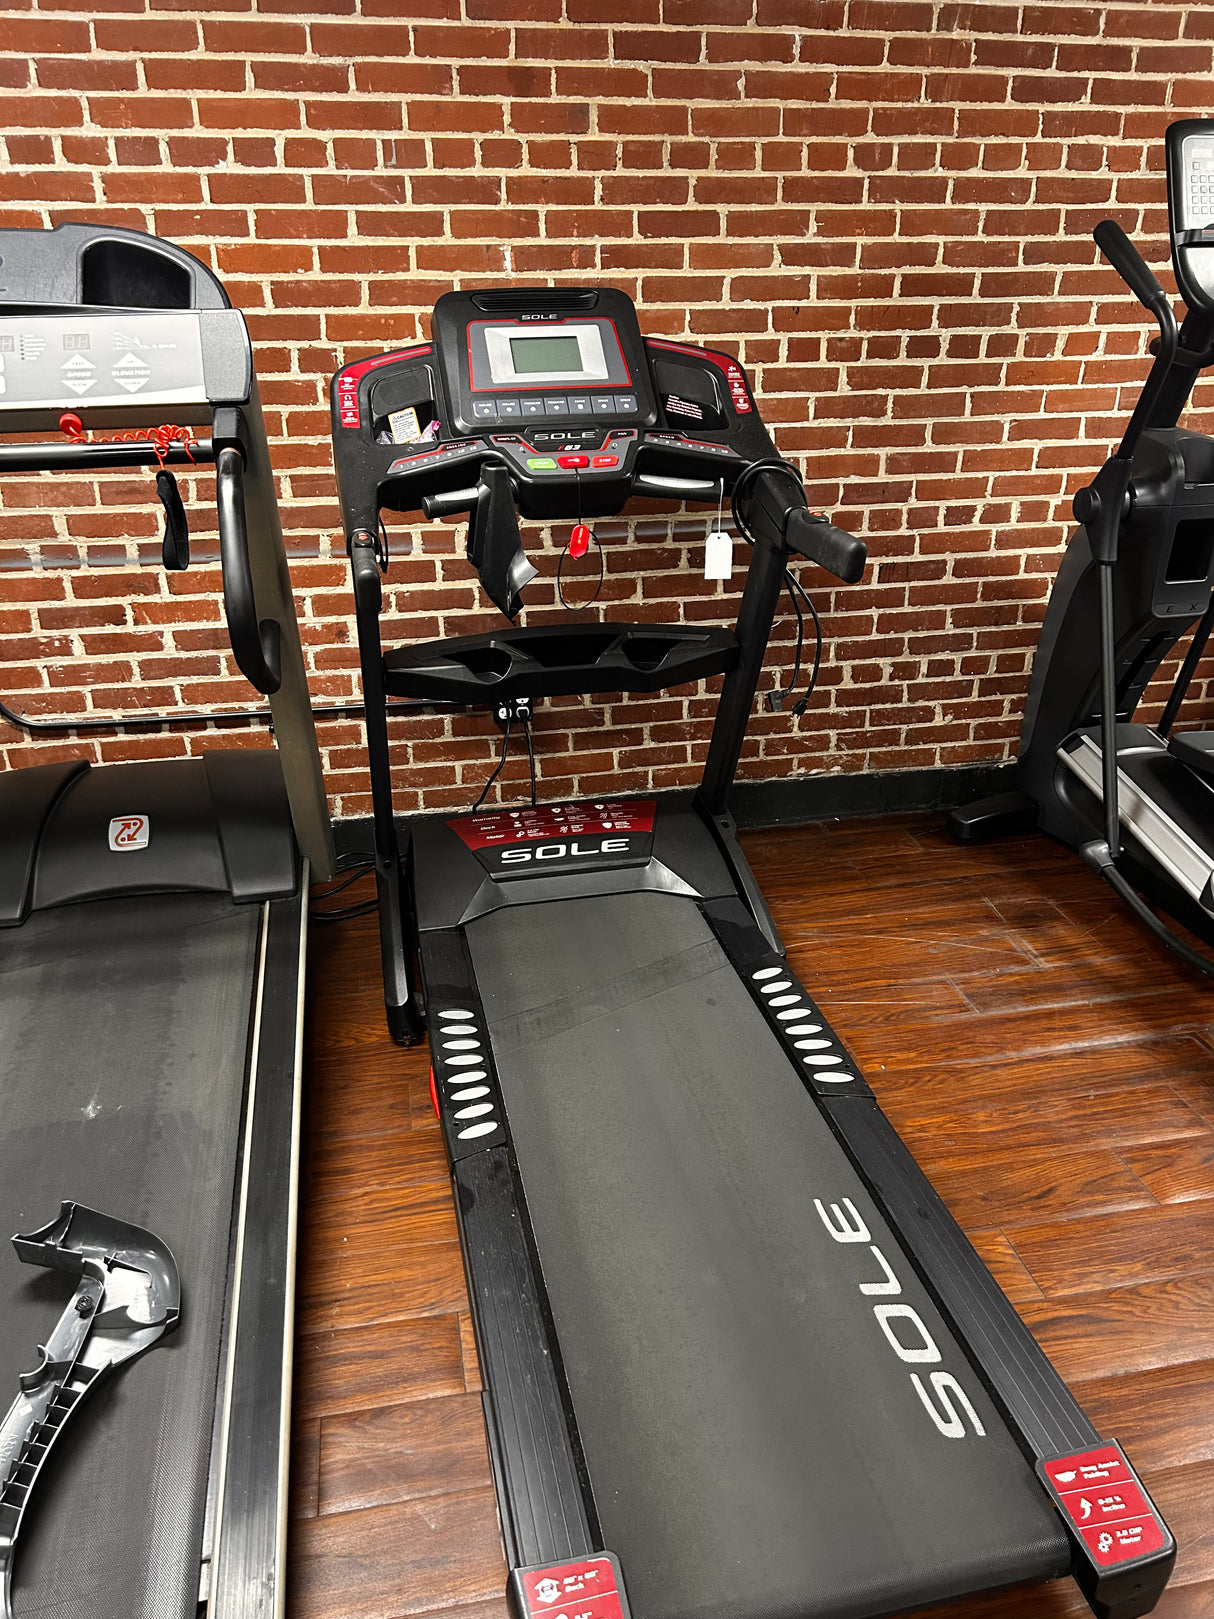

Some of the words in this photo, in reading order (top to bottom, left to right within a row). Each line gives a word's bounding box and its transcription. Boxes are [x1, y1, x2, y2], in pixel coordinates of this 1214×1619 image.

[534, 431, 596, 441] SOLE
[501, 838, 630, 864] SOLE
[813, 1197, 987, 1439] SOLE
[1102, 1503, 1126, 1512] Incline
[1115, 1530, 1128, 1538] 3.0
[1120, 1536, 1141, 1544] Motor
